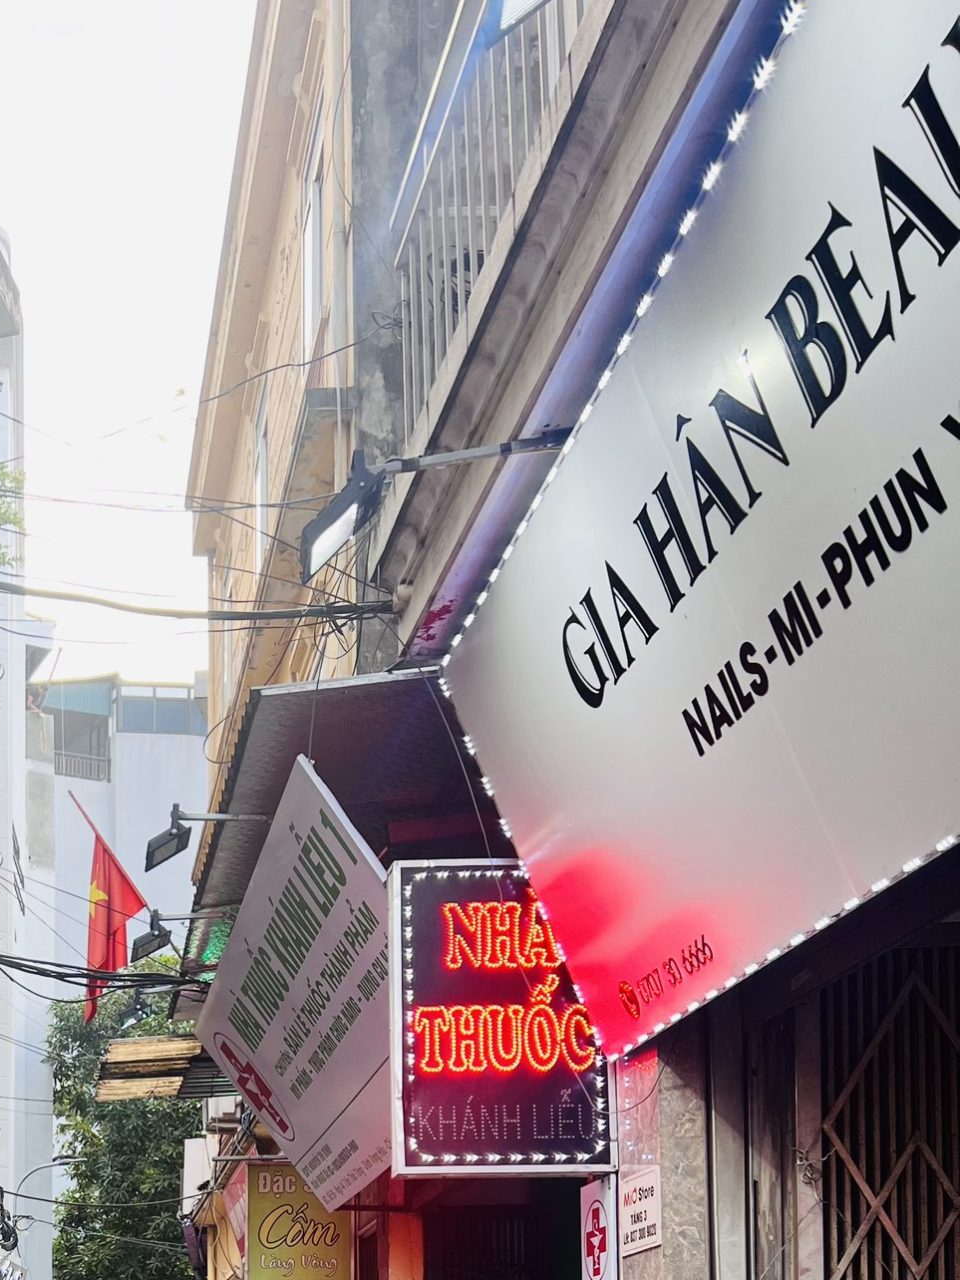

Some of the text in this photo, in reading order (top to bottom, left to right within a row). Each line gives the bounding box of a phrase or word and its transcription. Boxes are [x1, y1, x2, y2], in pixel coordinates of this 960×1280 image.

[562, 559, 660, 708] GIA
[632, 350, 789, 611] HÂN
[227, 808, 358, 1054] NHÀ THUỐC KHÁNH LIỄU 1
[300, 977, 331, 1027] THUỐC
[320, 952, 355, 993] THÀNH
[343, 899, 380, 956] PHẨM
[413, 974, 597, 1072] THUỐC
[416, 1094, 521, 1141] KHÁNH
[258, 1172, 297, 1198] Đặc
[638, 1185, 655, 1202] Store
[258, 1203, 340, 1249] Cốm
[259, 1254, 338, 1277] Làng Vòng
